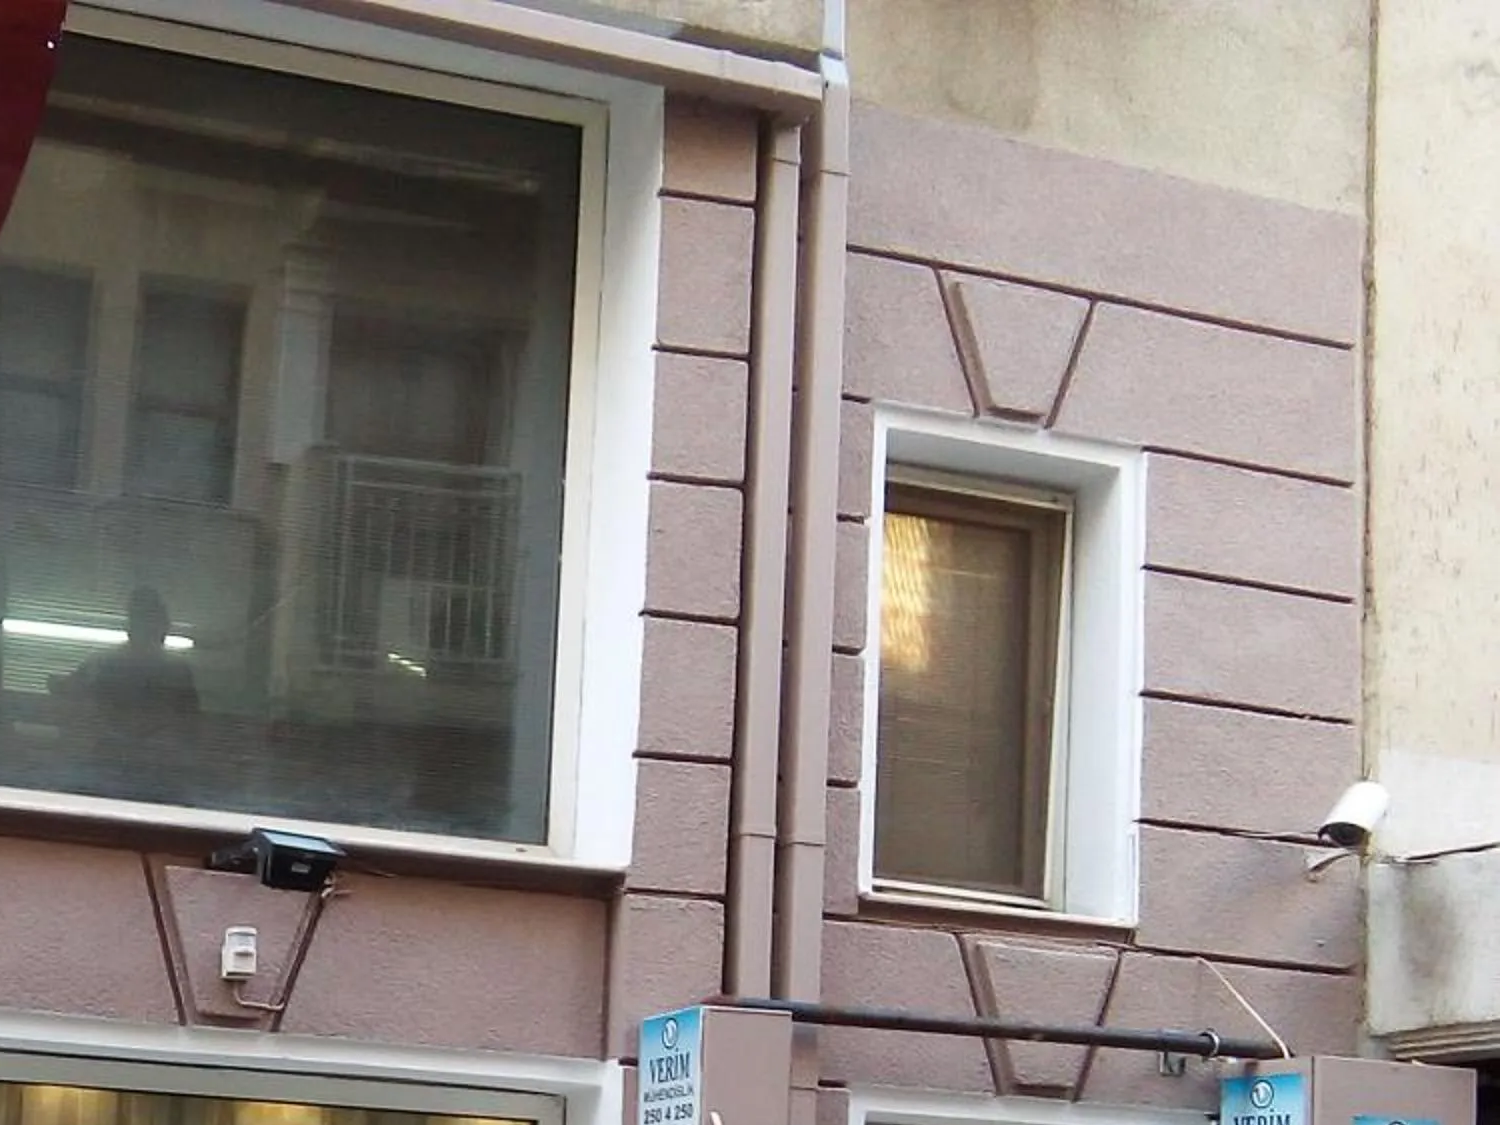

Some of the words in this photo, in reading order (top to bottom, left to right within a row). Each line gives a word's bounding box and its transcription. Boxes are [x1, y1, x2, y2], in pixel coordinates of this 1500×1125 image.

[643, 1107, 662, 1125] 250
[664, 1106, 672, 1121] 4
[674, 1103, 694, 1121] 250
